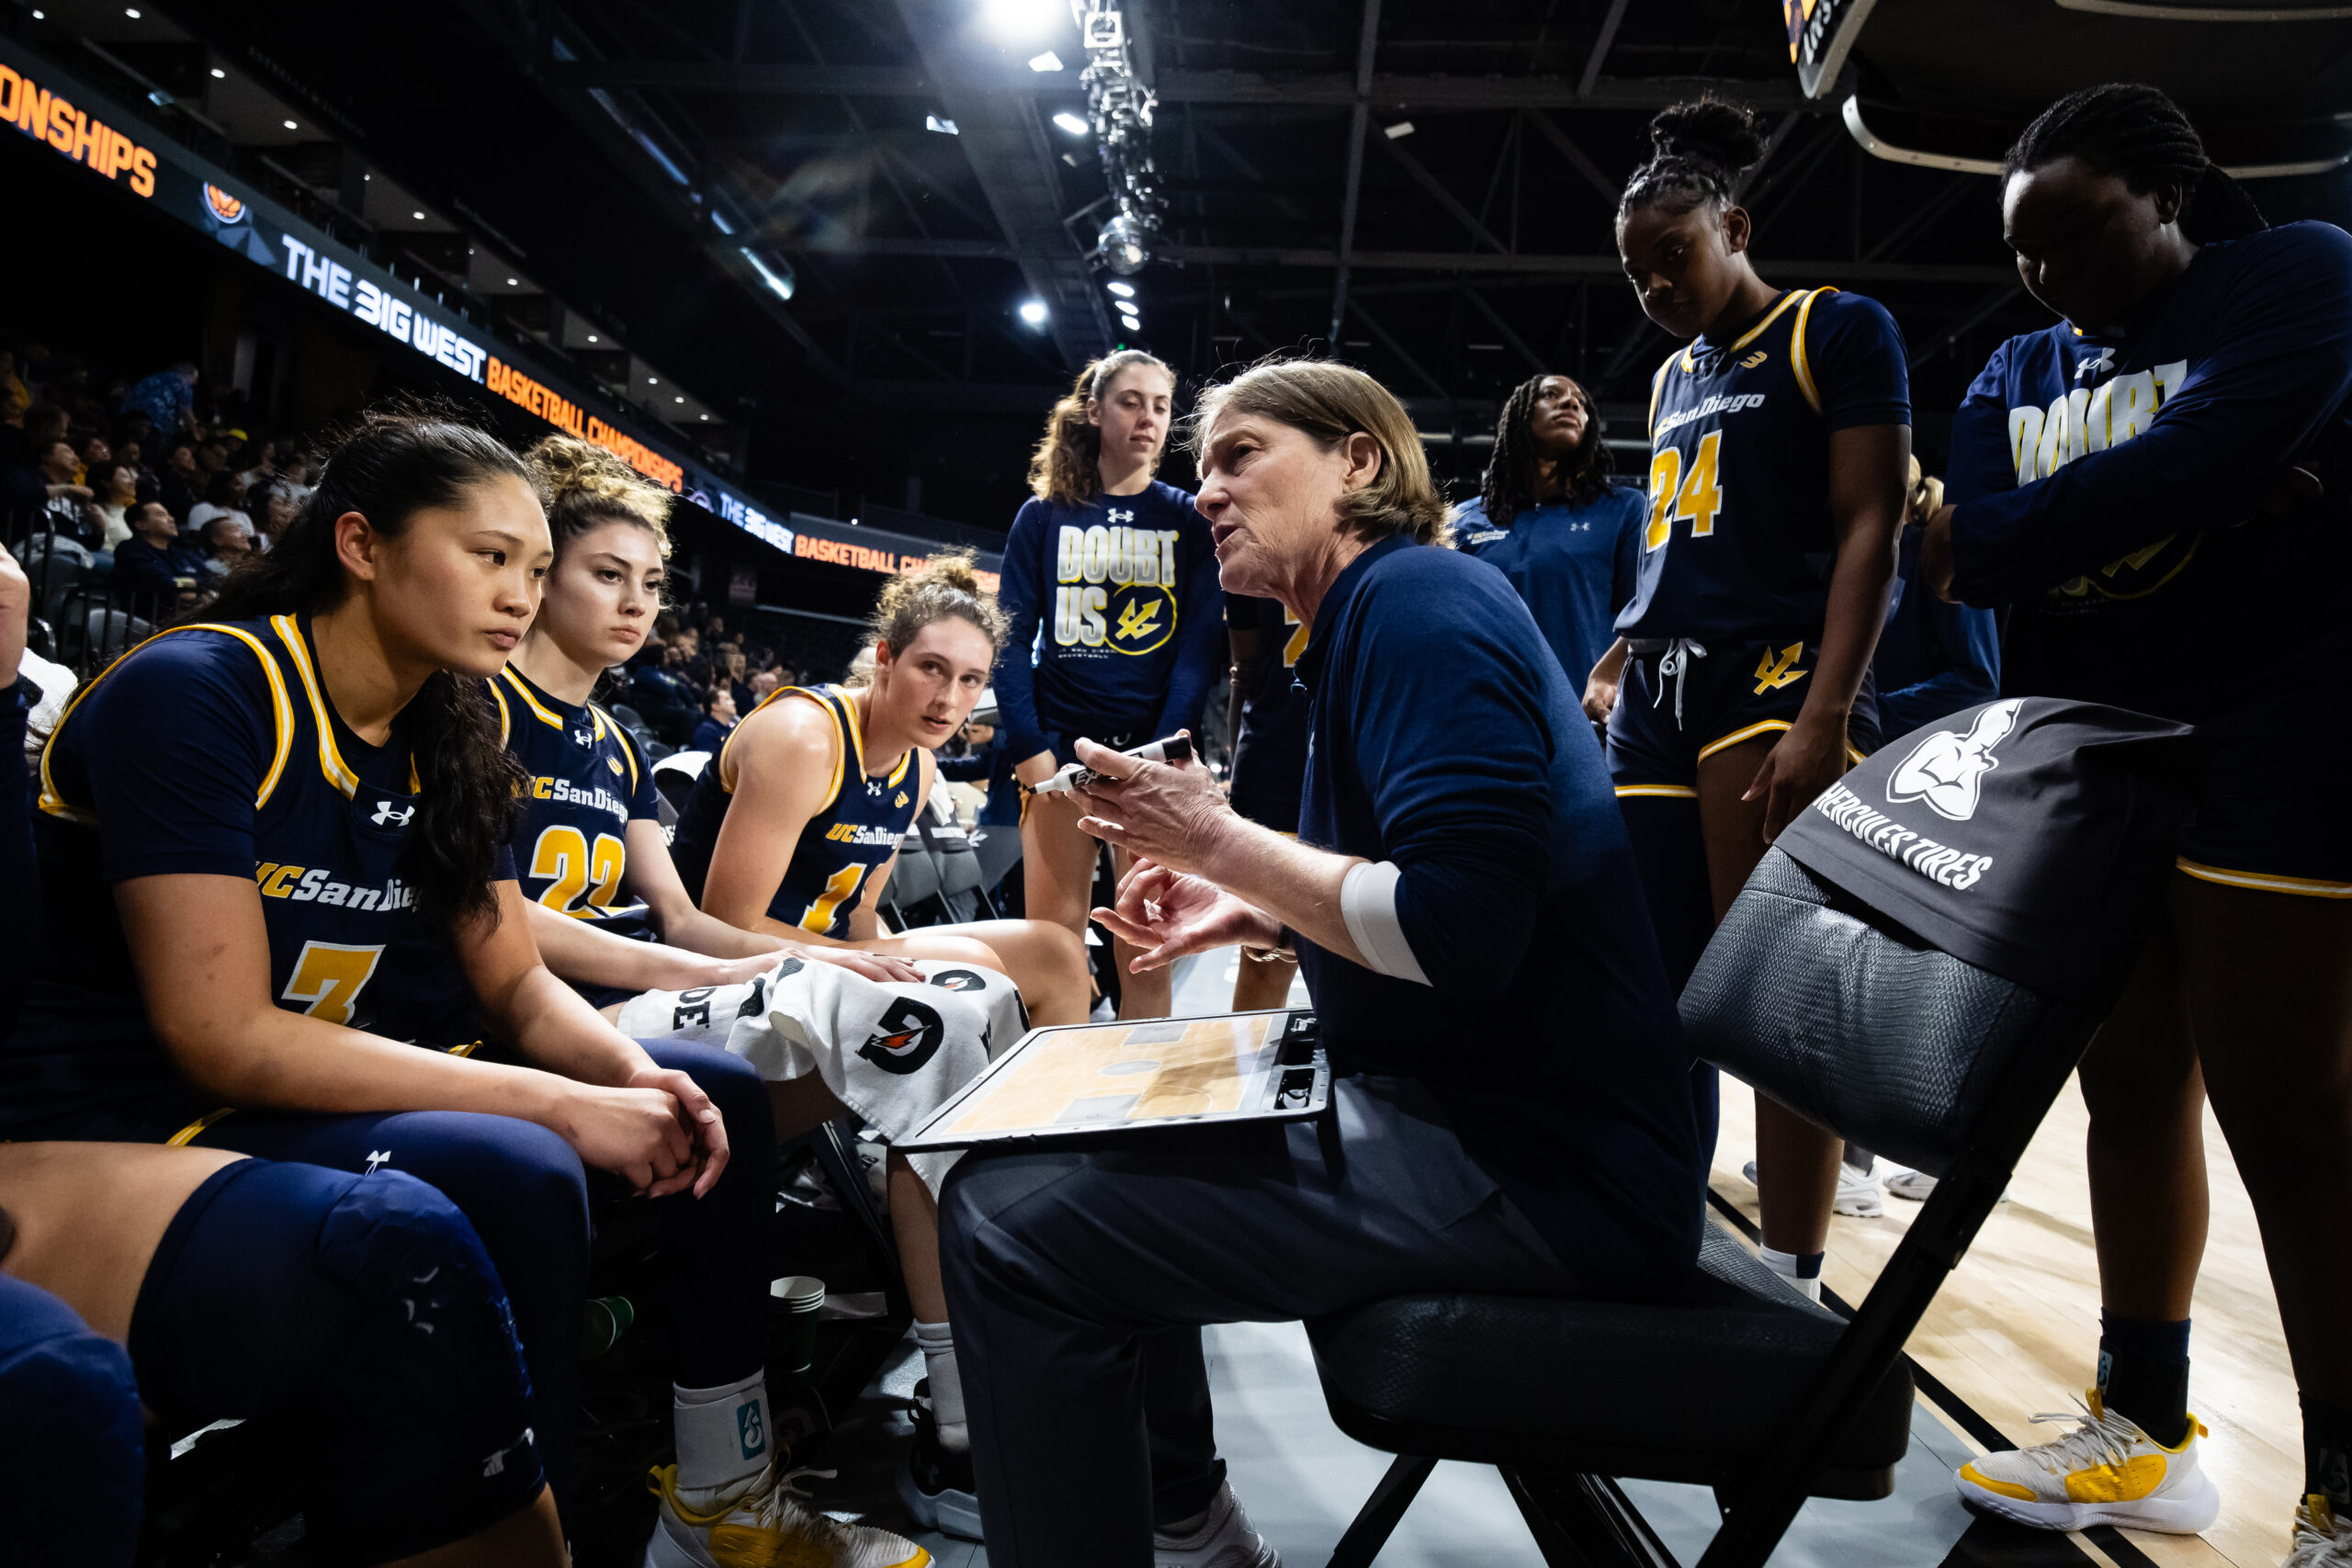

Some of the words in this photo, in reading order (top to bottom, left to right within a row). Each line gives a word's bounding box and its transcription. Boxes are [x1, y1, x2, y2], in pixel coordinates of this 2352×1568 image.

[282, 232, 352, 310] THE
[413, 311, 487, 382] WEST
[486, 355, 585, 439] BASKETBALL
[720, 491, 745, 530] THE
[795, 534, 899, 575] BASKETBALL
[1645, 428, 1723, 554] 24
[1057, 525, 1180, 588] DOUBT
[1055, 585, 1108, 647] US
[528, 824, 649, 919] 22
[1812, 781, 1918, 860] HERCULES
[1902, 838, 1994, 891] TIRES
[797, 862, 868, 935] 1
[280, 940, 387, 1026] 7
